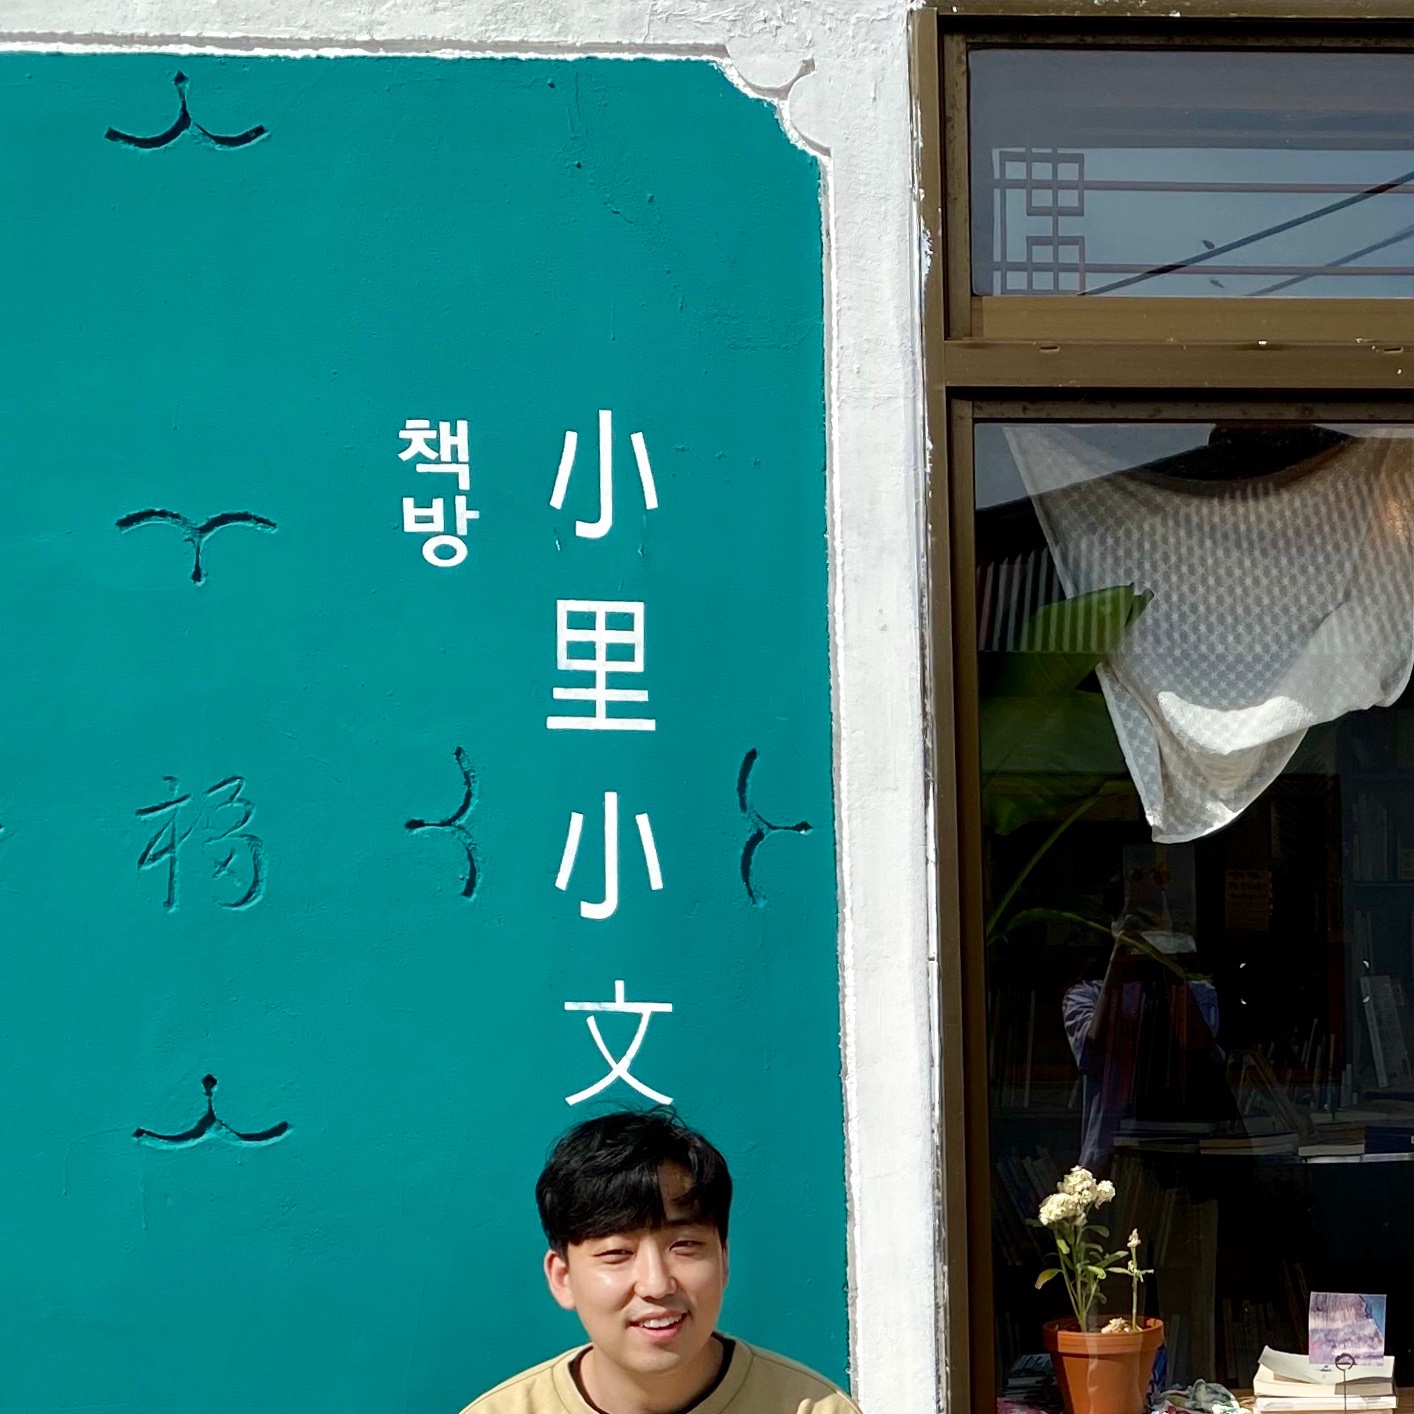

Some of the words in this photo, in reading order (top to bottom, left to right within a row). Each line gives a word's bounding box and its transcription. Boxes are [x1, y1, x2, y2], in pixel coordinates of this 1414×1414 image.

[398, 418, 480, 568] 책방
[546, 408, 674, 1107] 小里小文
